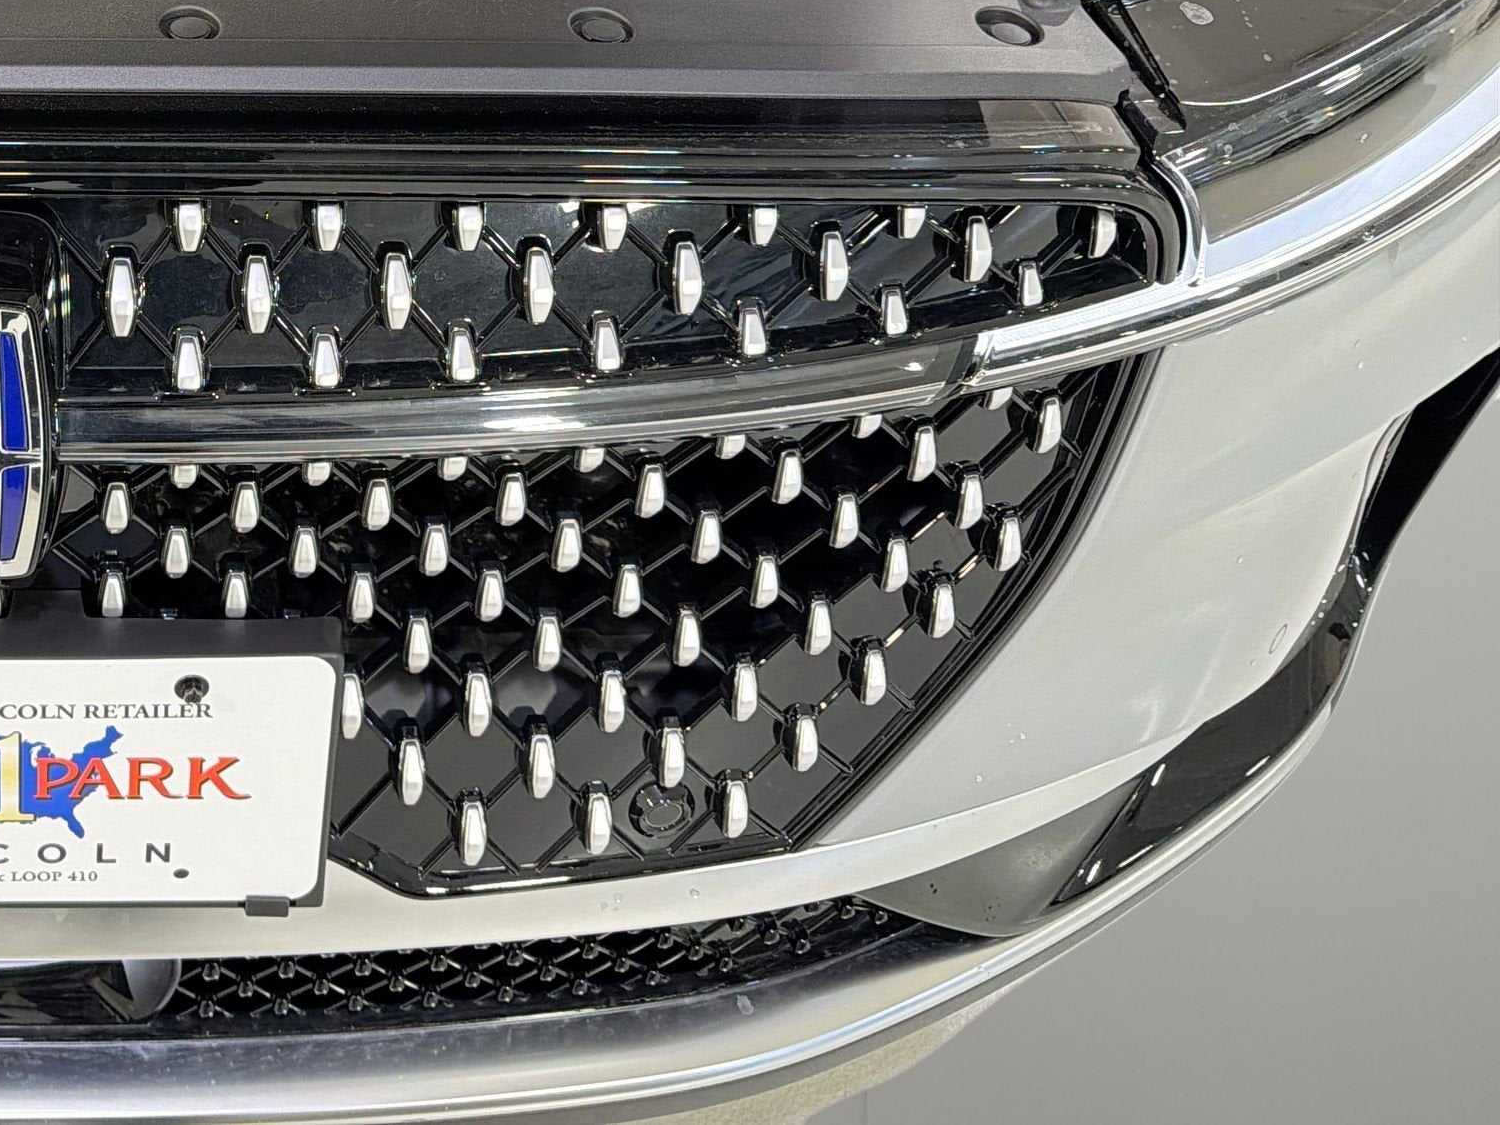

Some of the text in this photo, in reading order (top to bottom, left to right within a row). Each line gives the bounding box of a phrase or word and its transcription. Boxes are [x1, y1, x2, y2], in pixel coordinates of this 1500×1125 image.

[83, 702, 214, 720] RETAILER
[34, 755, 252, 801] PARK
[11, 869, 63, 883] LOOP
[67, 869, 99, 883] 410
